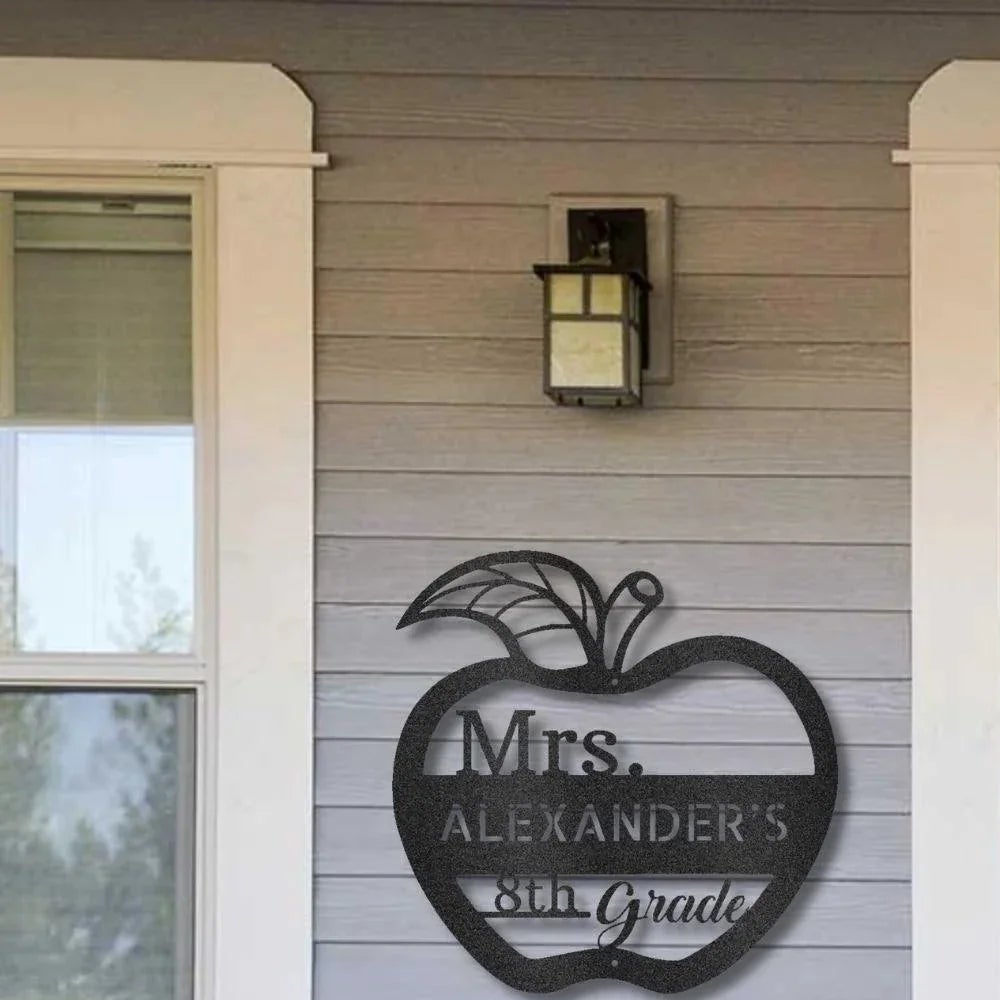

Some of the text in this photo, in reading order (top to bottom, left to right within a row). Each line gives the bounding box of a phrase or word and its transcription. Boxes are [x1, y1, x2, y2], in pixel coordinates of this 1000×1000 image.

[456, 709, 643, 775] Mrs.
[440, 803, 789, 842] ALEXANDER'S
[494, 873, 746, 948] 8th Grade
